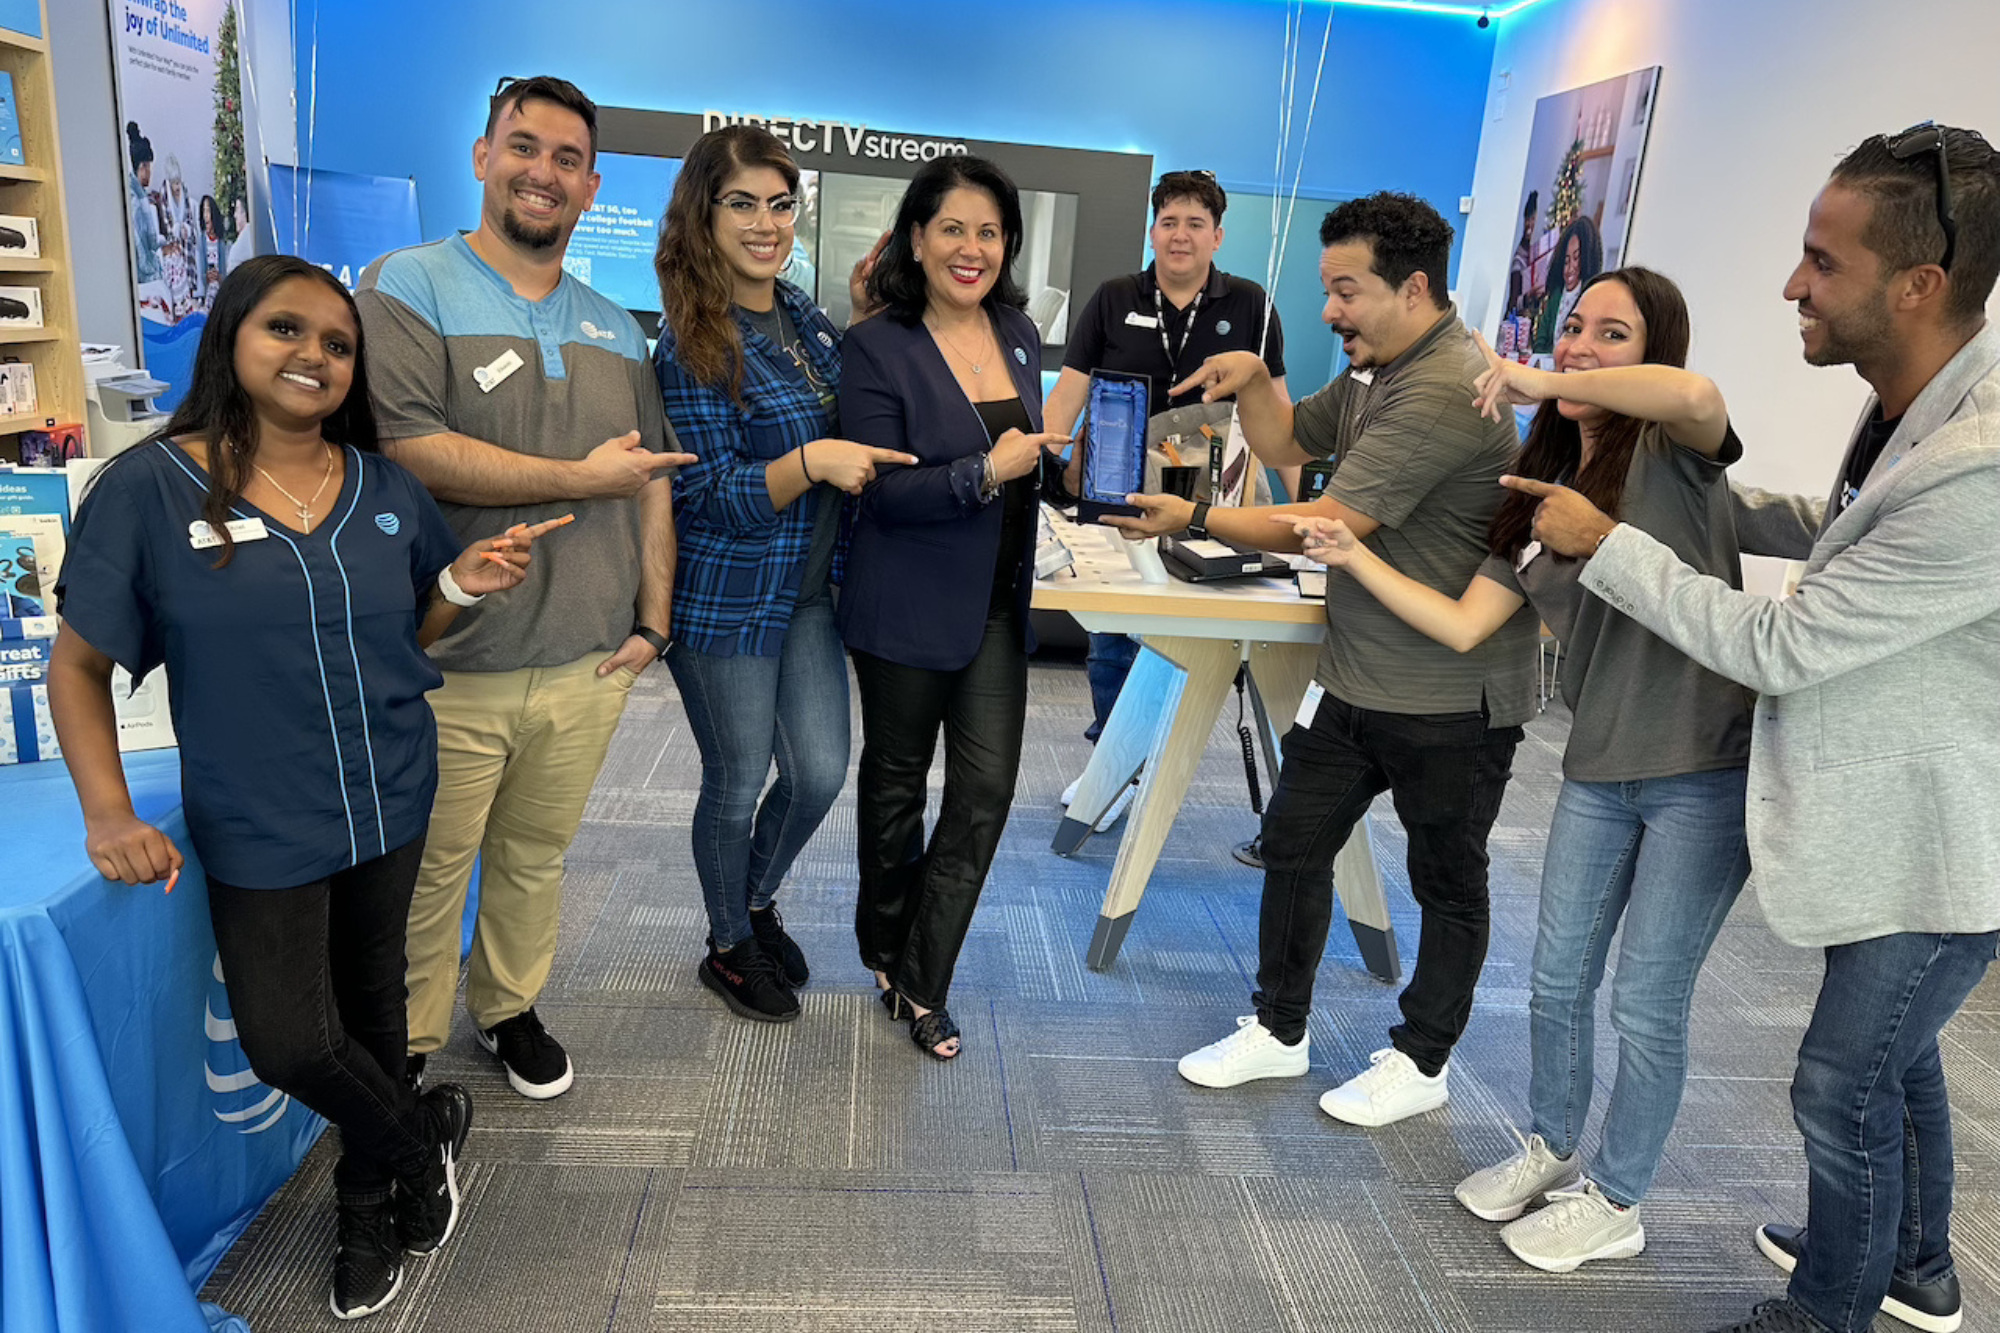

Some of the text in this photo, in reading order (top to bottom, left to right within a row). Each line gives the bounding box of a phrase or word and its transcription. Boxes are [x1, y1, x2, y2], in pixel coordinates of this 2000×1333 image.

[128, 0, 187, 22] wrap the
[125, 6, 210, 55] joy of Unlimited
[622, 207, 638, 215] too
[586, 215, 618, 225] college
[618, 216, 654, 227] football
[596, 226, 612, 234] too
[613, 228, 640, 236] much.
[338, 265, 353, 287] A
[1, 645, 43, 661] reat
[127, 721, 154, 729] AirPods
